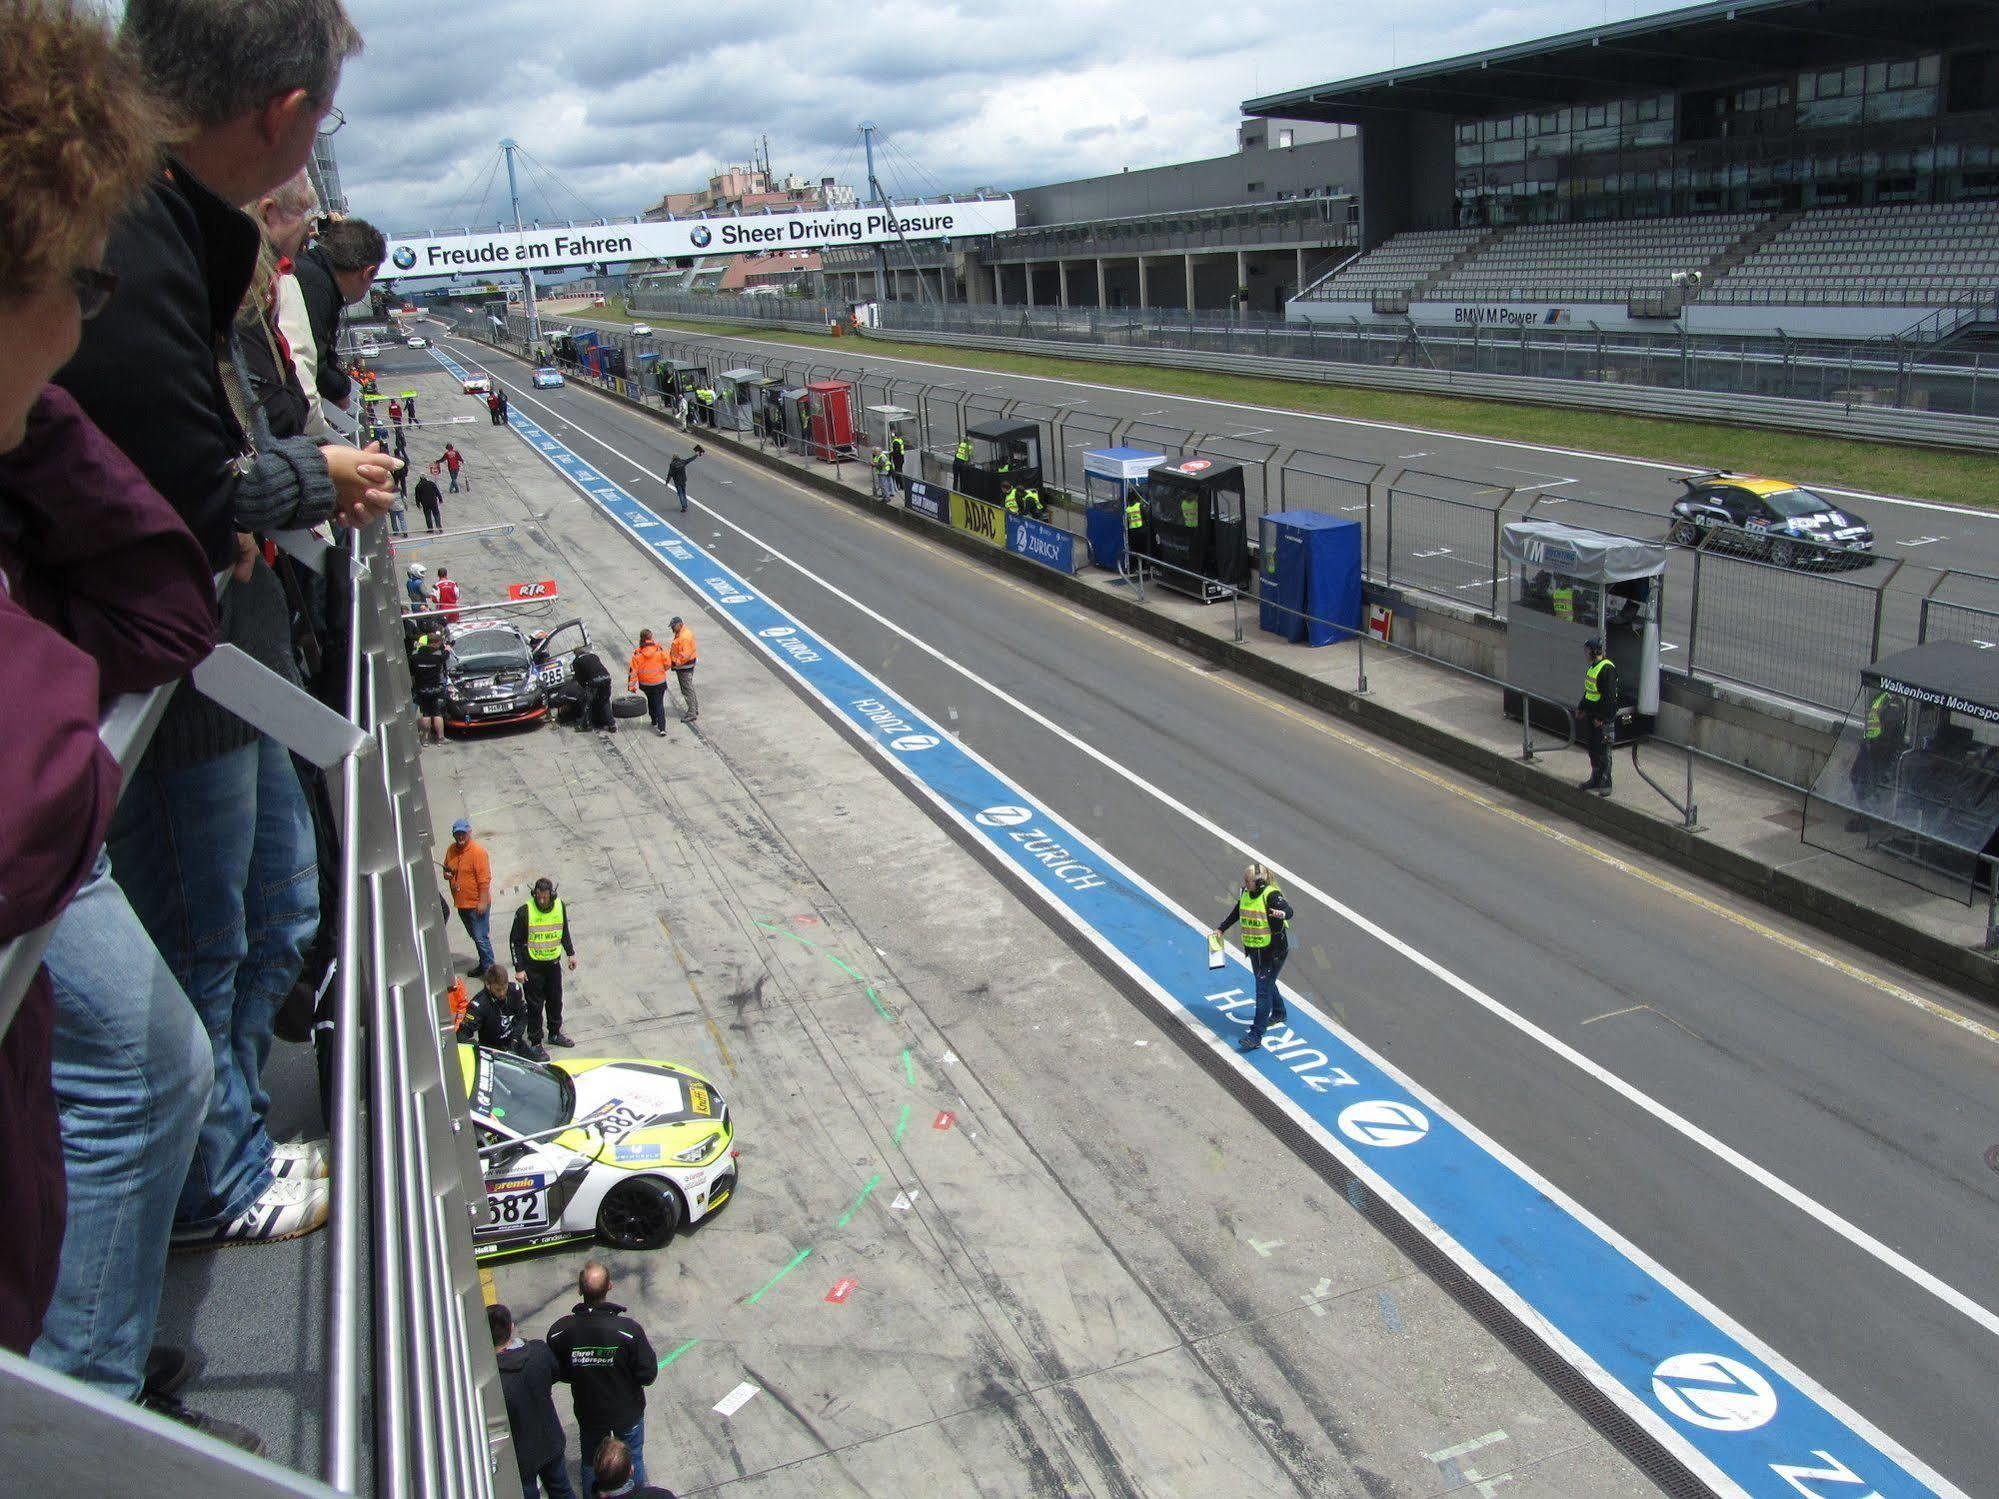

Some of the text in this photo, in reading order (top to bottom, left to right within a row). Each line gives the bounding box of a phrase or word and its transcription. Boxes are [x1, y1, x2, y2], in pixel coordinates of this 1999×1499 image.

[722, 214, 954, 244] Sheer Driving Pleasure
[427, 235, 632, 266] Freude am Fahren
[1455, 308, 1537, 325] BMW M Power
[963, 499, 996, 539] ADAC
[1028, 535, 1060, 561] ZURICH
[519, 583, 545, 596] RTR
[776, 637, 823, 663] ZURICH
[541, 668, 563, 686] 285
[1880, 677, 1945, 706] Walkenhorst
[852, 698, 913, 735] ZURICH
[1010, 828, 1105, 890] ZURICH
[601, 1107, 644, 1134] 682
[493, 1178, 535, 1192] premio
